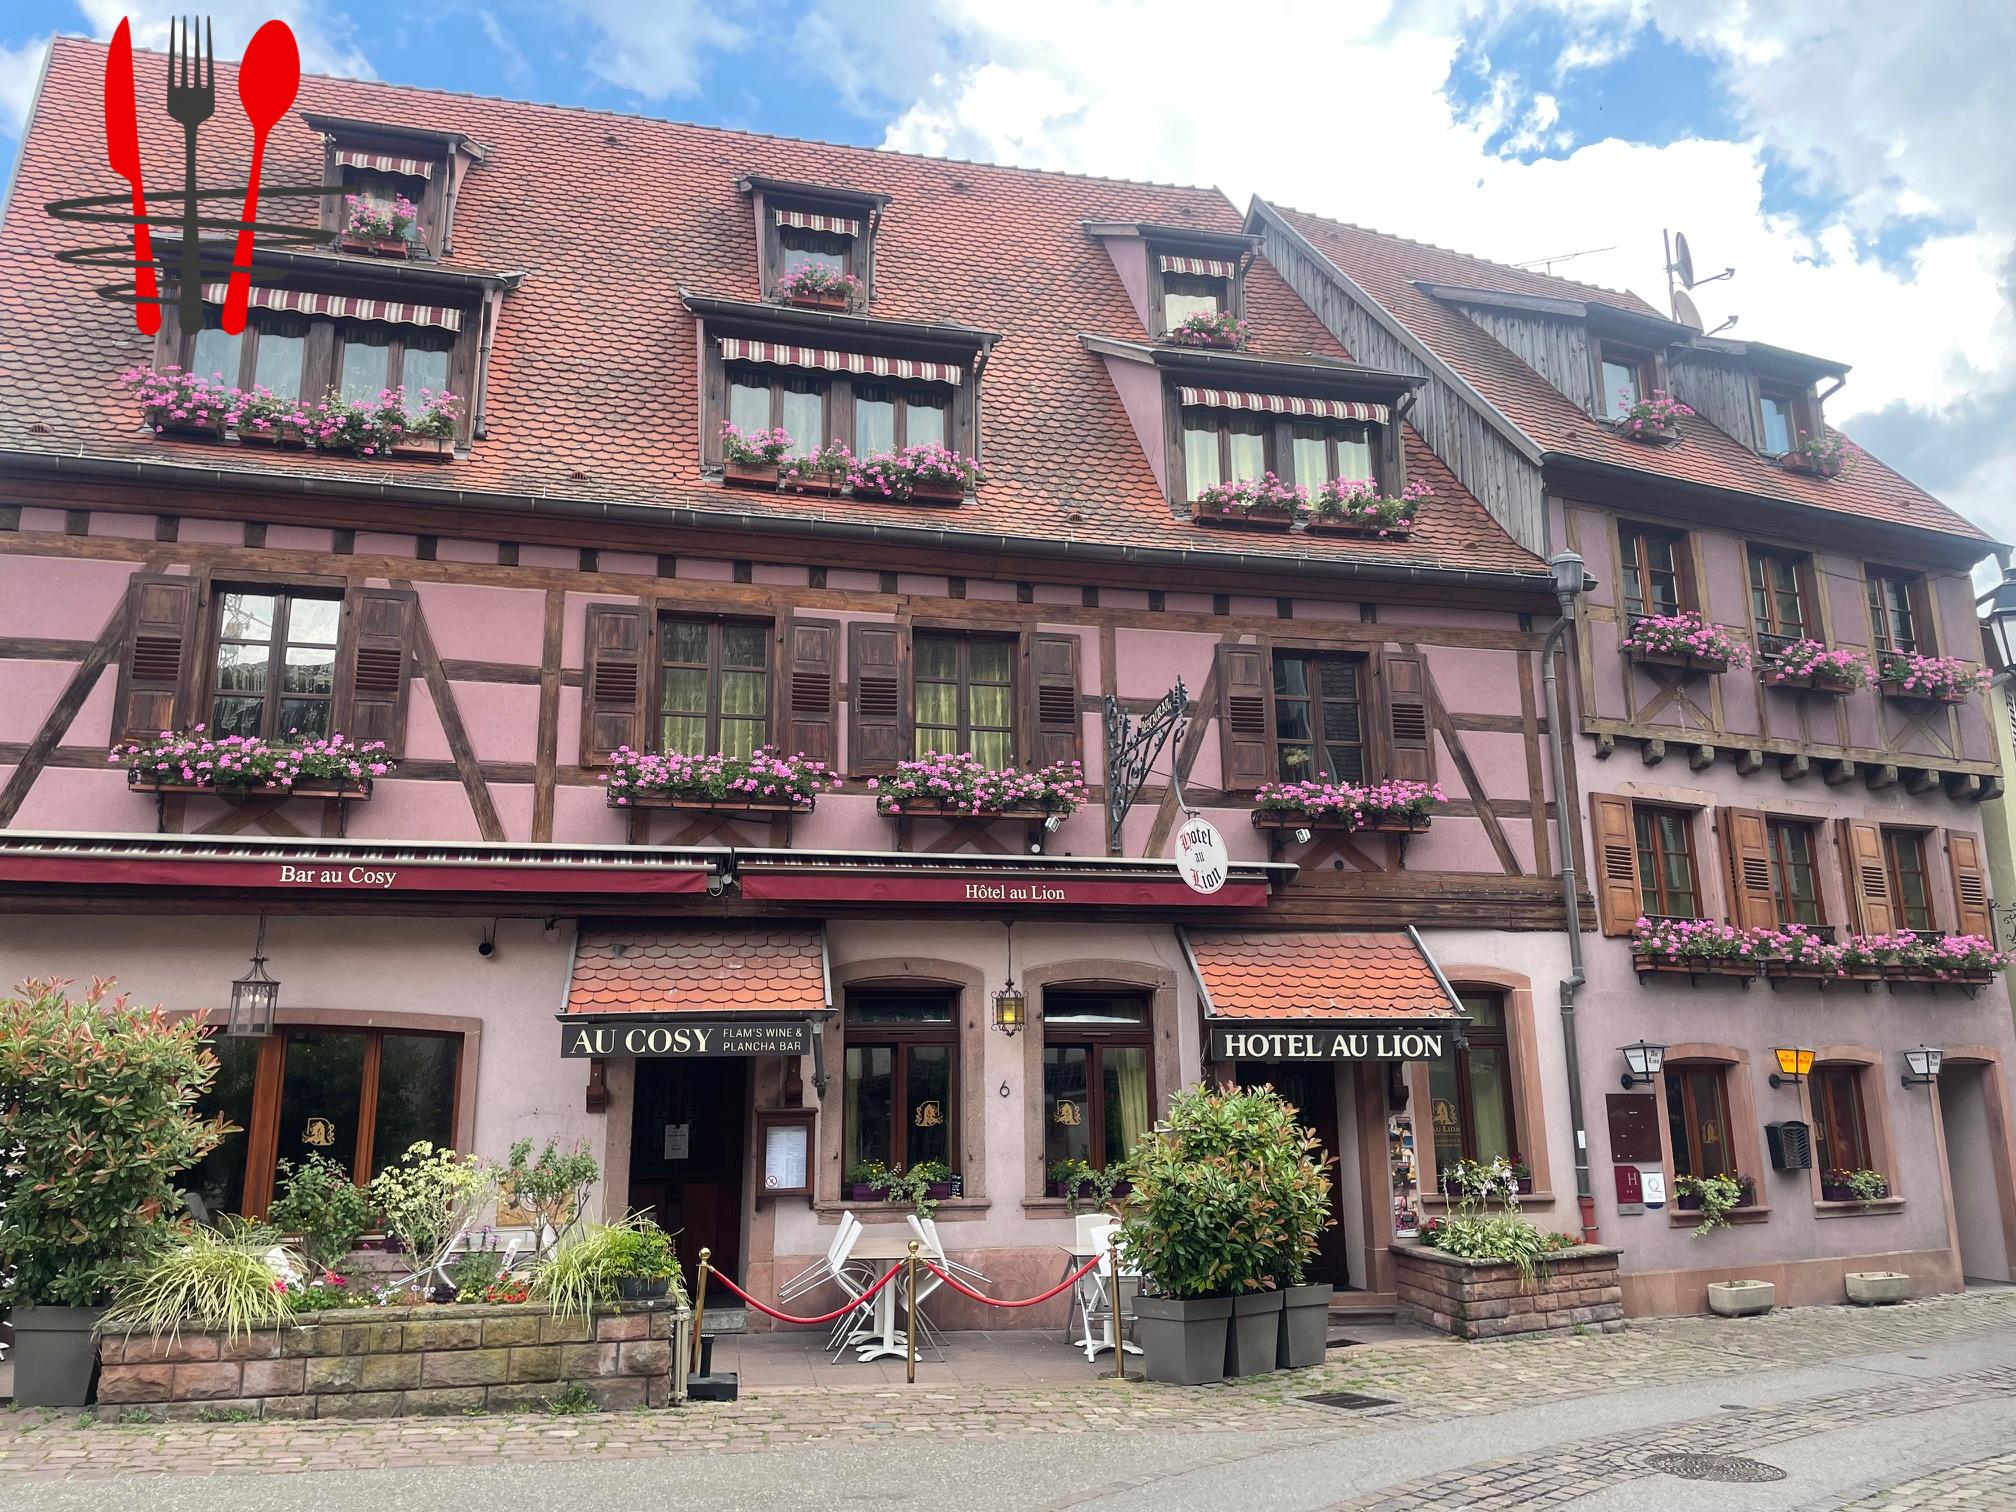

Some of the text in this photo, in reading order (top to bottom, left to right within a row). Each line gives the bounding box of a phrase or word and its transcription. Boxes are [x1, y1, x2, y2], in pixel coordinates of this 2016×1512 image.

[1195, 851, 1206, 864] au
[279, 865, 397, 889] Bar au Cosy
[1190, 868, 1222, 890] Lion
[965, 884, 1066, 900] Hôtel au Lion
[570, 1028, 715, 1054] AU COSY
[723, 1027, 803, 1038] FLAM'S WINE &
[723, 1041, 801, 1052] PLANCHA BAR
[1225, 1034, 1443, 1058] HOTEL AU LION
[999, 1079, 1010, 1098] 6
[1628, 1172, 1639, 1187] H
